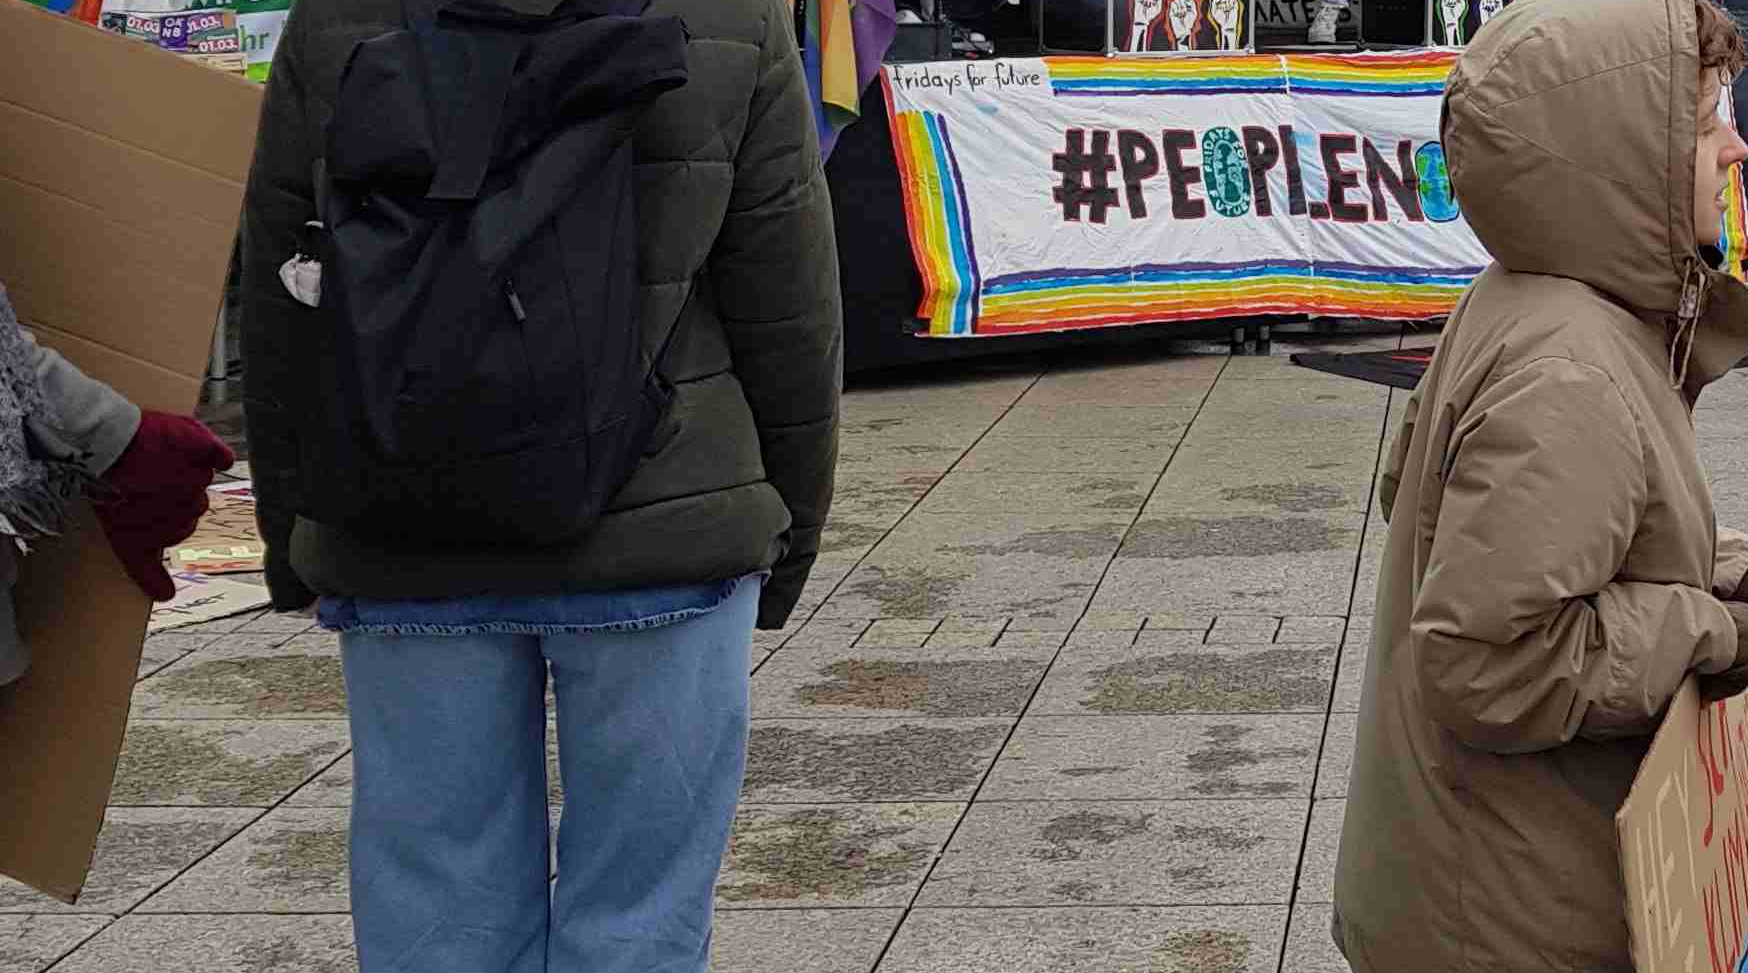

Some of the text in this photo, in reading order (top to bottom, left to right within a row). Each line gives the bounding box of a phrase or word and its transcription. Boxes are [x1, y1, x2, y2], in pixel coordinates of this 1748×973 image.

[240, 25, 270, 52] hr
[966, 64, 986, 92] for
[995, 63, 1041, 90] future
